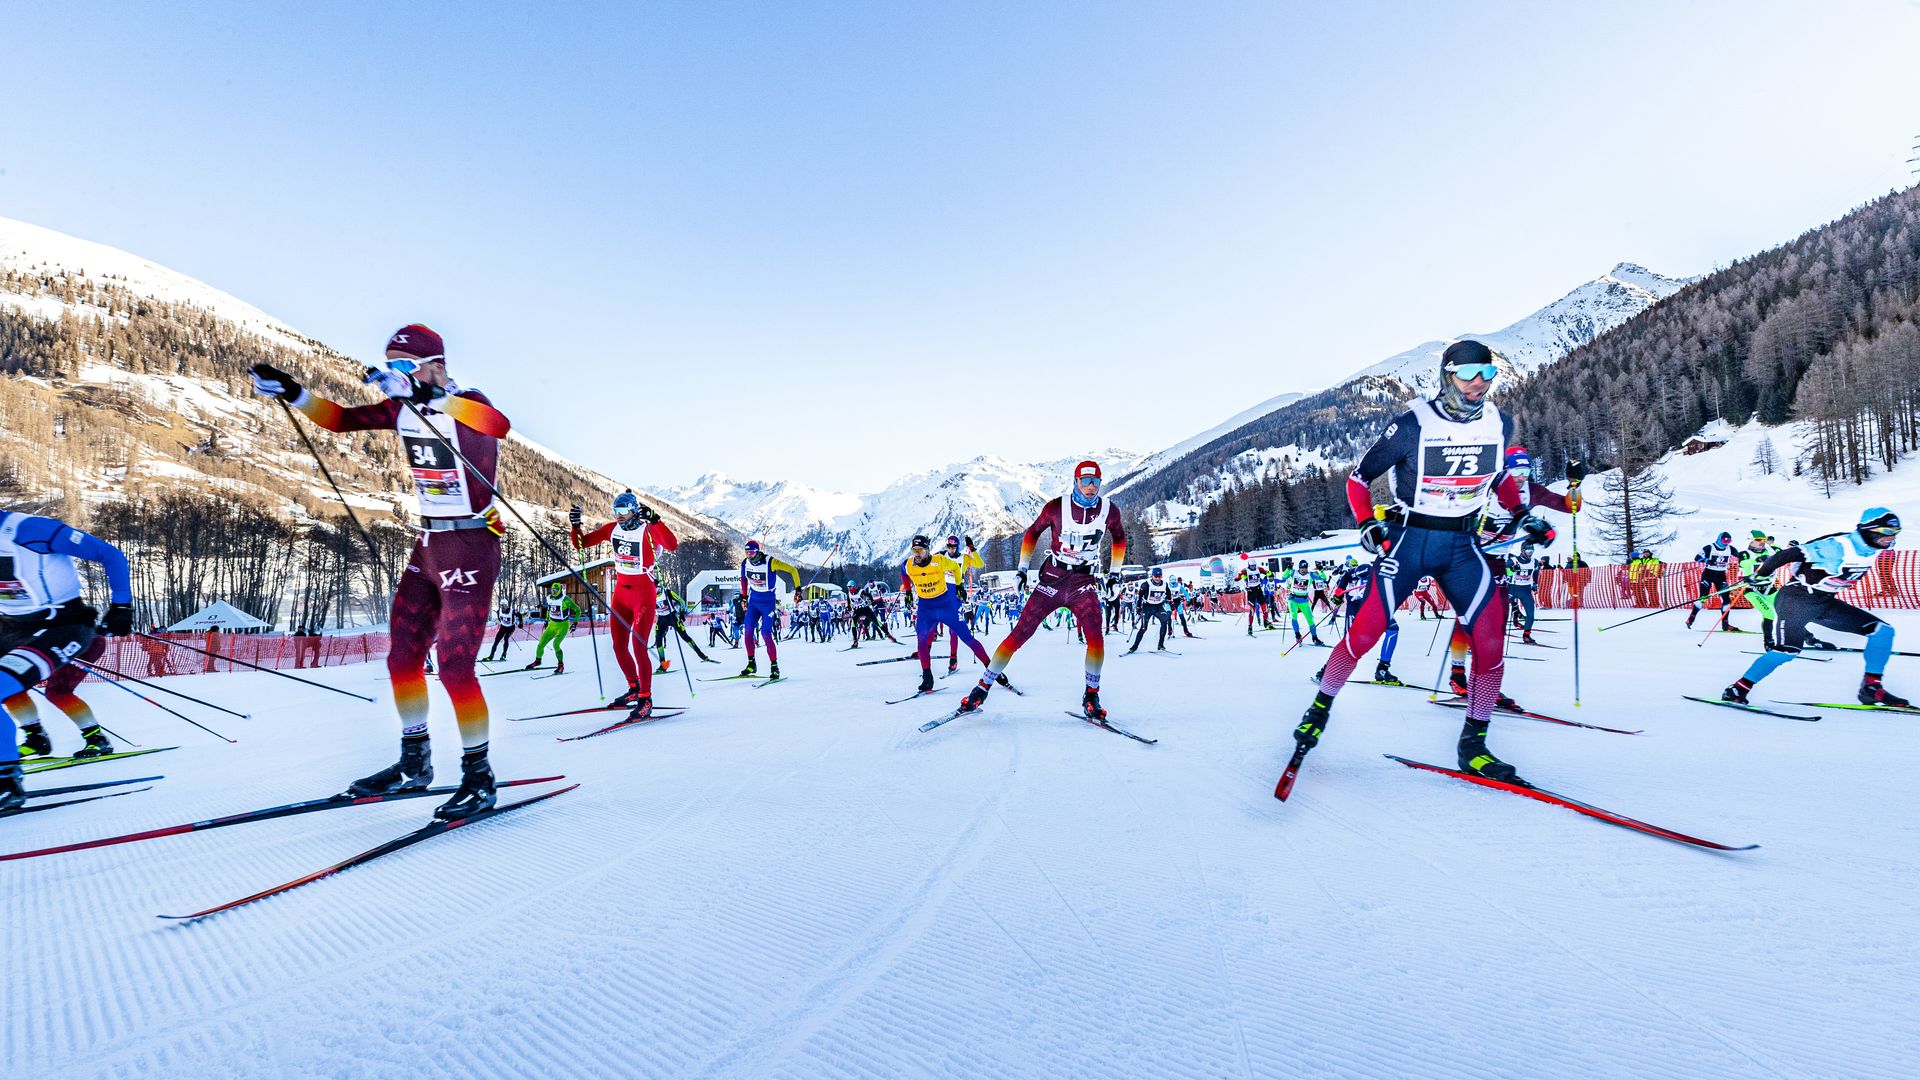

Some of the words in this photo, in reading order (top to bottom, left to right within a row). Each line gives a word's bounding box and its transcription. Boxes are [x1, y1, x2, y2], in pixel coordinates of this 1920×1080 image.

[411, 445, 437, 466] 34
[1445, 455, 1478, 476] 73
[617, 545, 632, 556] 68
[438, 567, 480, 589] SAS
[750, 573, 761, 581] 43
